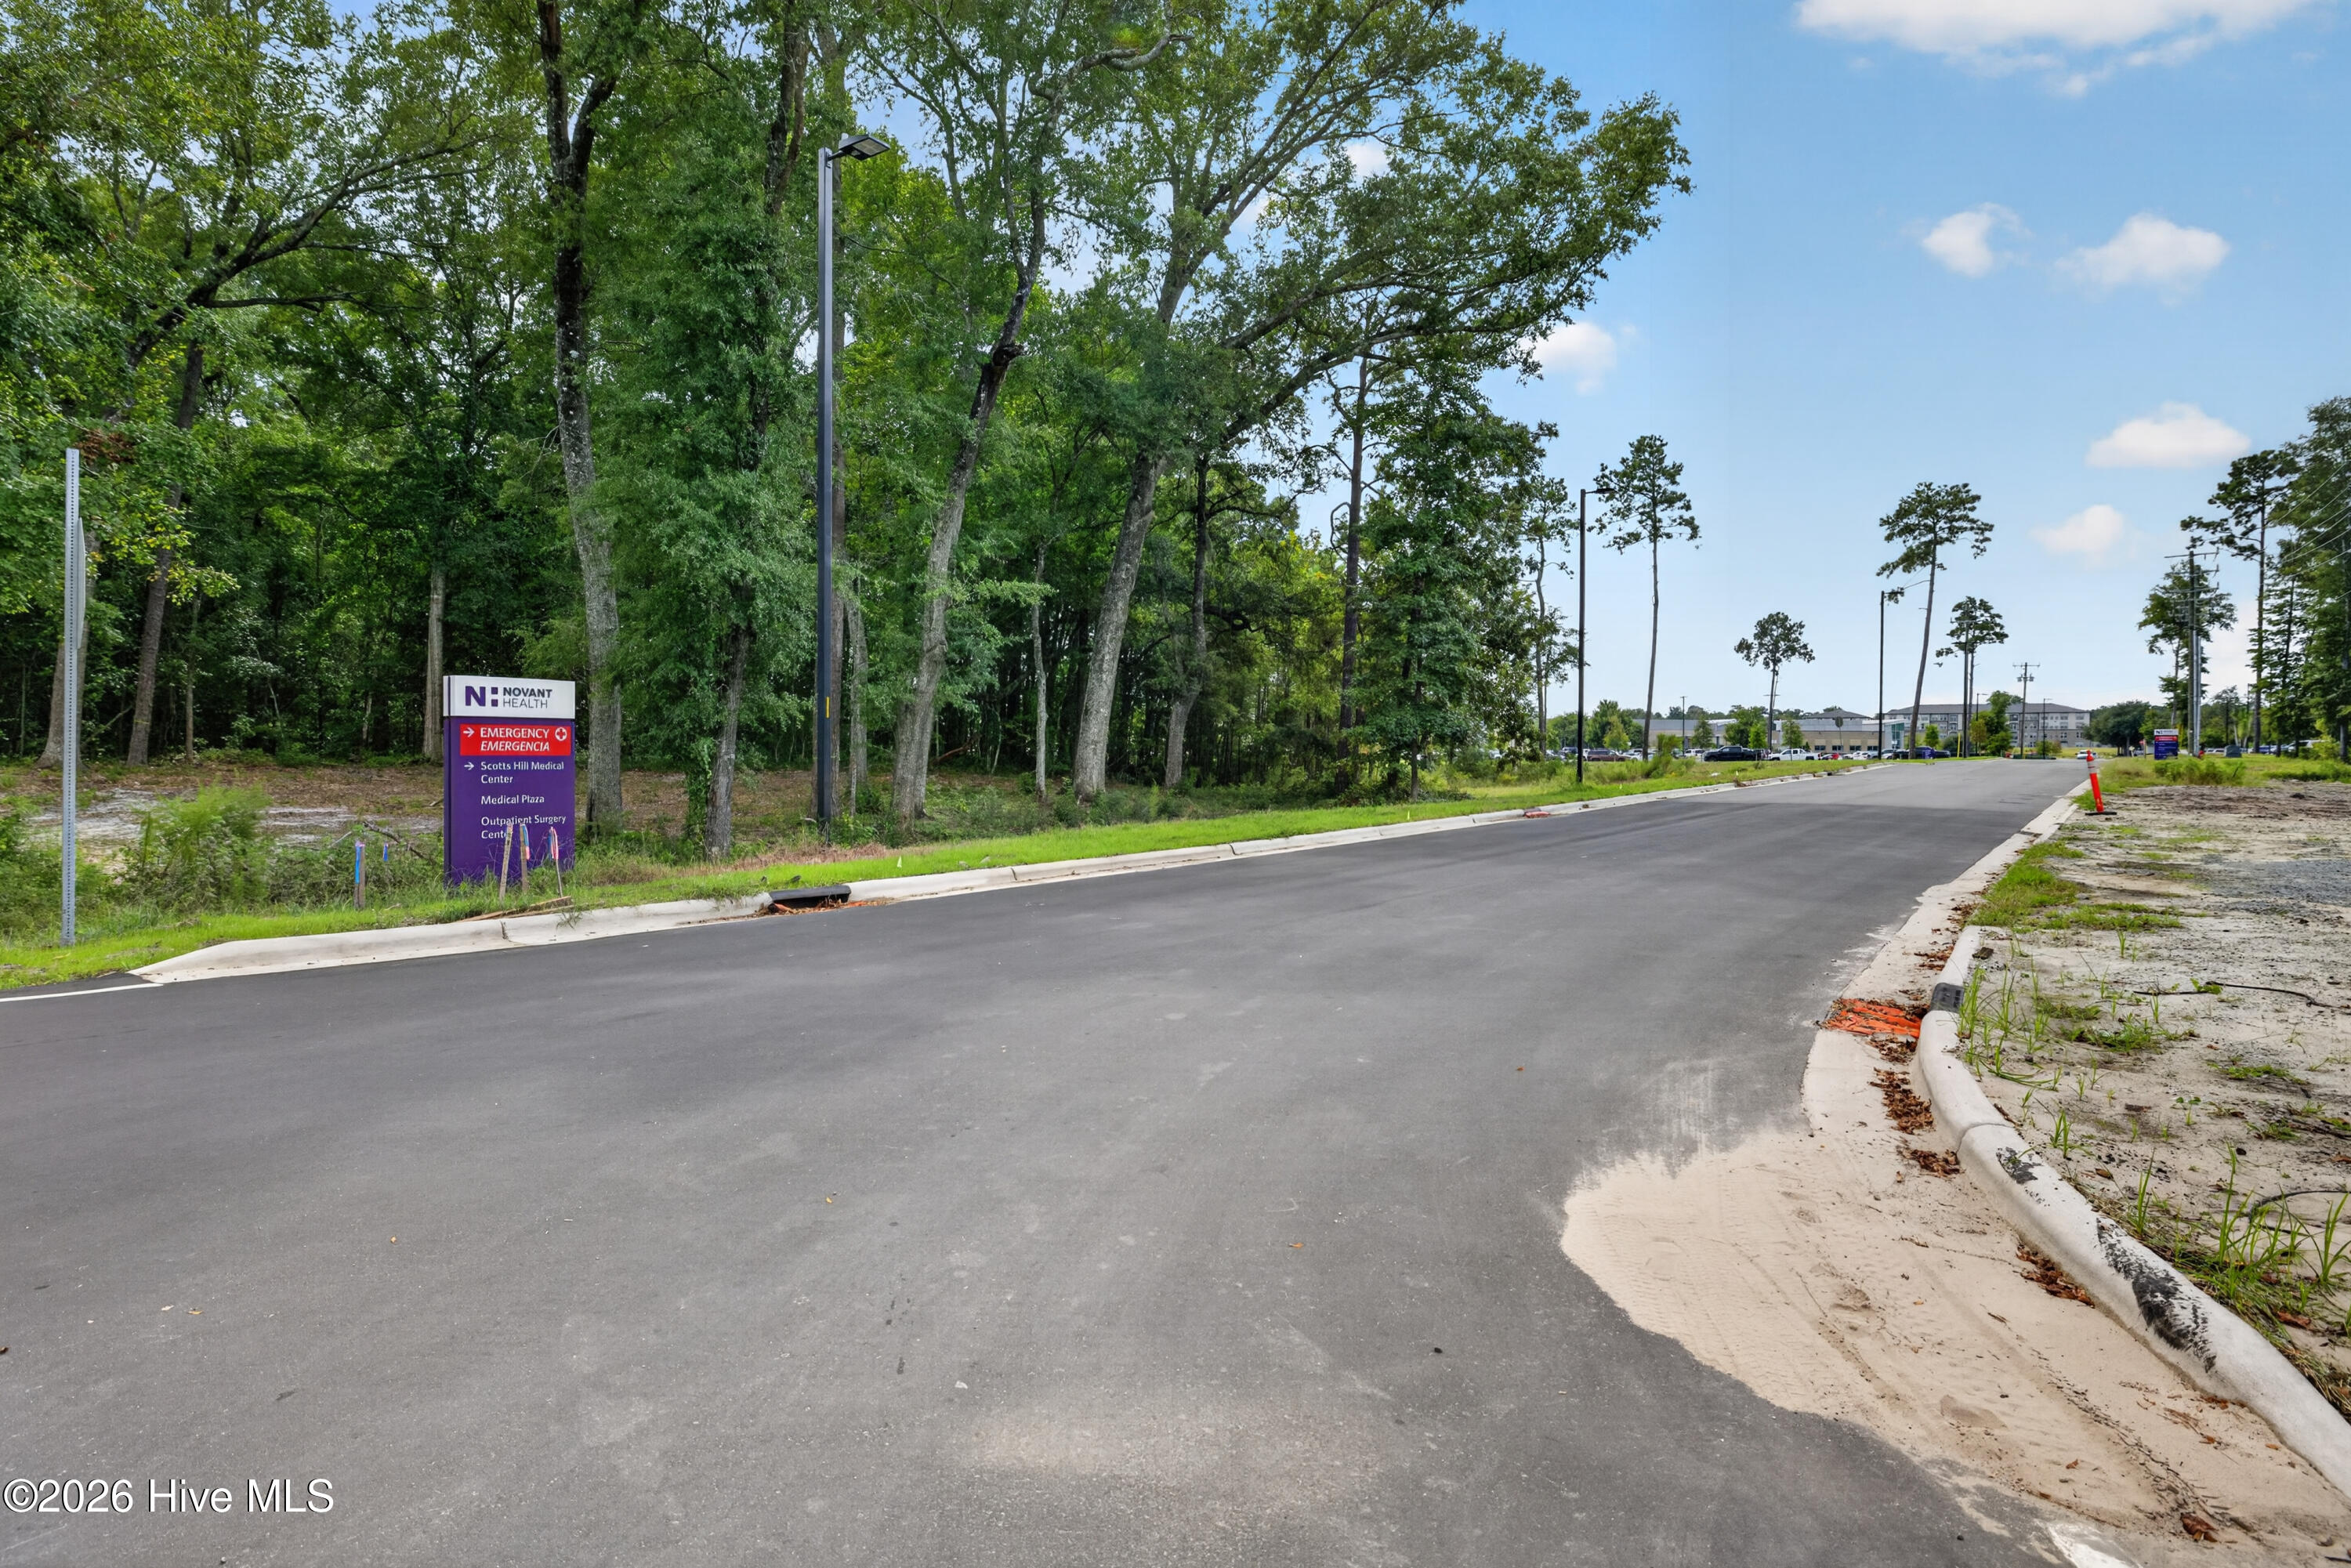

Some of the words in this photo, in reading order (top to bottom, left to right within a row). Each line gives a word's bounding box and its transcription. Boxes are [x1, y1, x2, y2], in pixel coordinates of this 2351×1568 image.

[503, 686, 553, 698] NOVANT
[503, 697, 548, 709] HEALTH
[480, 726, 550, 739] EMERGENCY
[480, 741, 550, 751] EMERGENCIA
[480, 761, 512, 770] Scotts
[513, 761, 529, 770] Hill
[531, 761, 564, 770] Medical
[480, 774, 513, 784] Center
[480, 795, 520, 805] Medical
[521, 794, 545, 803] Plaza
[534, 814, 567, 825] Surgery
[480, 830, 513, 839] Cent
